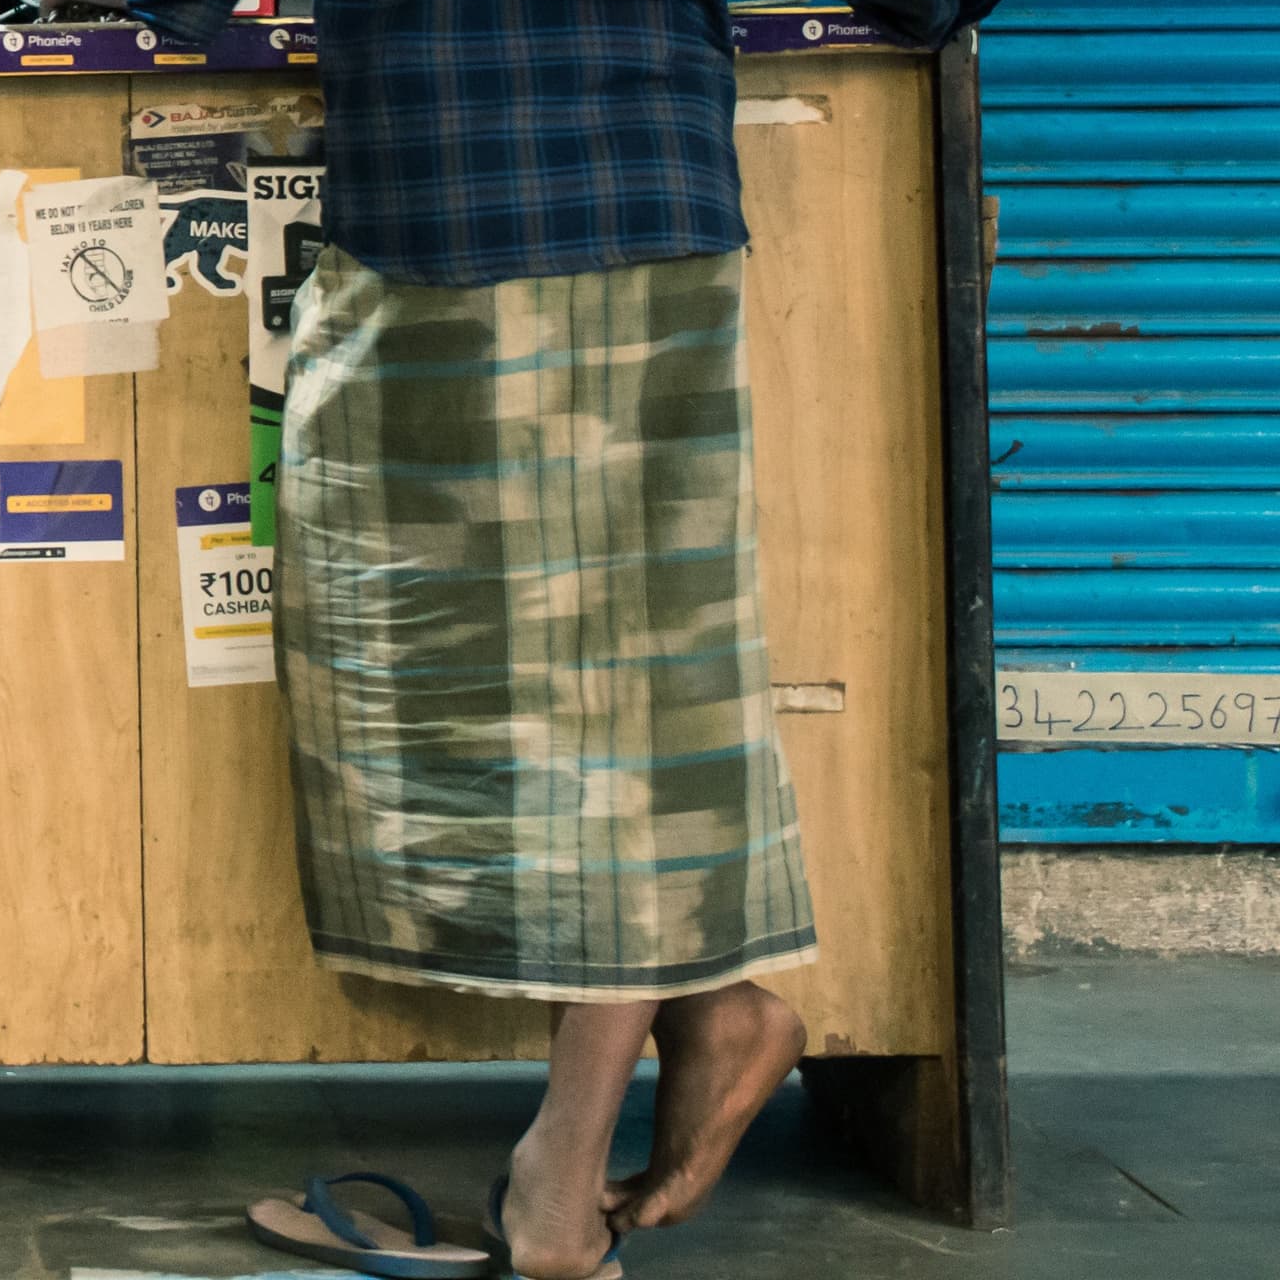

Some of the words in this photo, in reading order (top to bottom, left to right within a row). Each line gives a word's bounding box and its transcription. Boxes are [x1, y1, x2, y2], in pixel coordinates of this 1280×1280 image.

[28, 34, 82, 47] PhonePe
[35, 208, 47, 220] WE
[48, 207, 59, 218] DO
[60, 206, 75, 217] NOT
[50, 223, 76, 235] BELOW
[88, 219, 112, 232] YEARS
[113, 216, 134, 229] HERE
[190, 220, 247, 240] MAKE
[91, 238, 107, 248] TO
